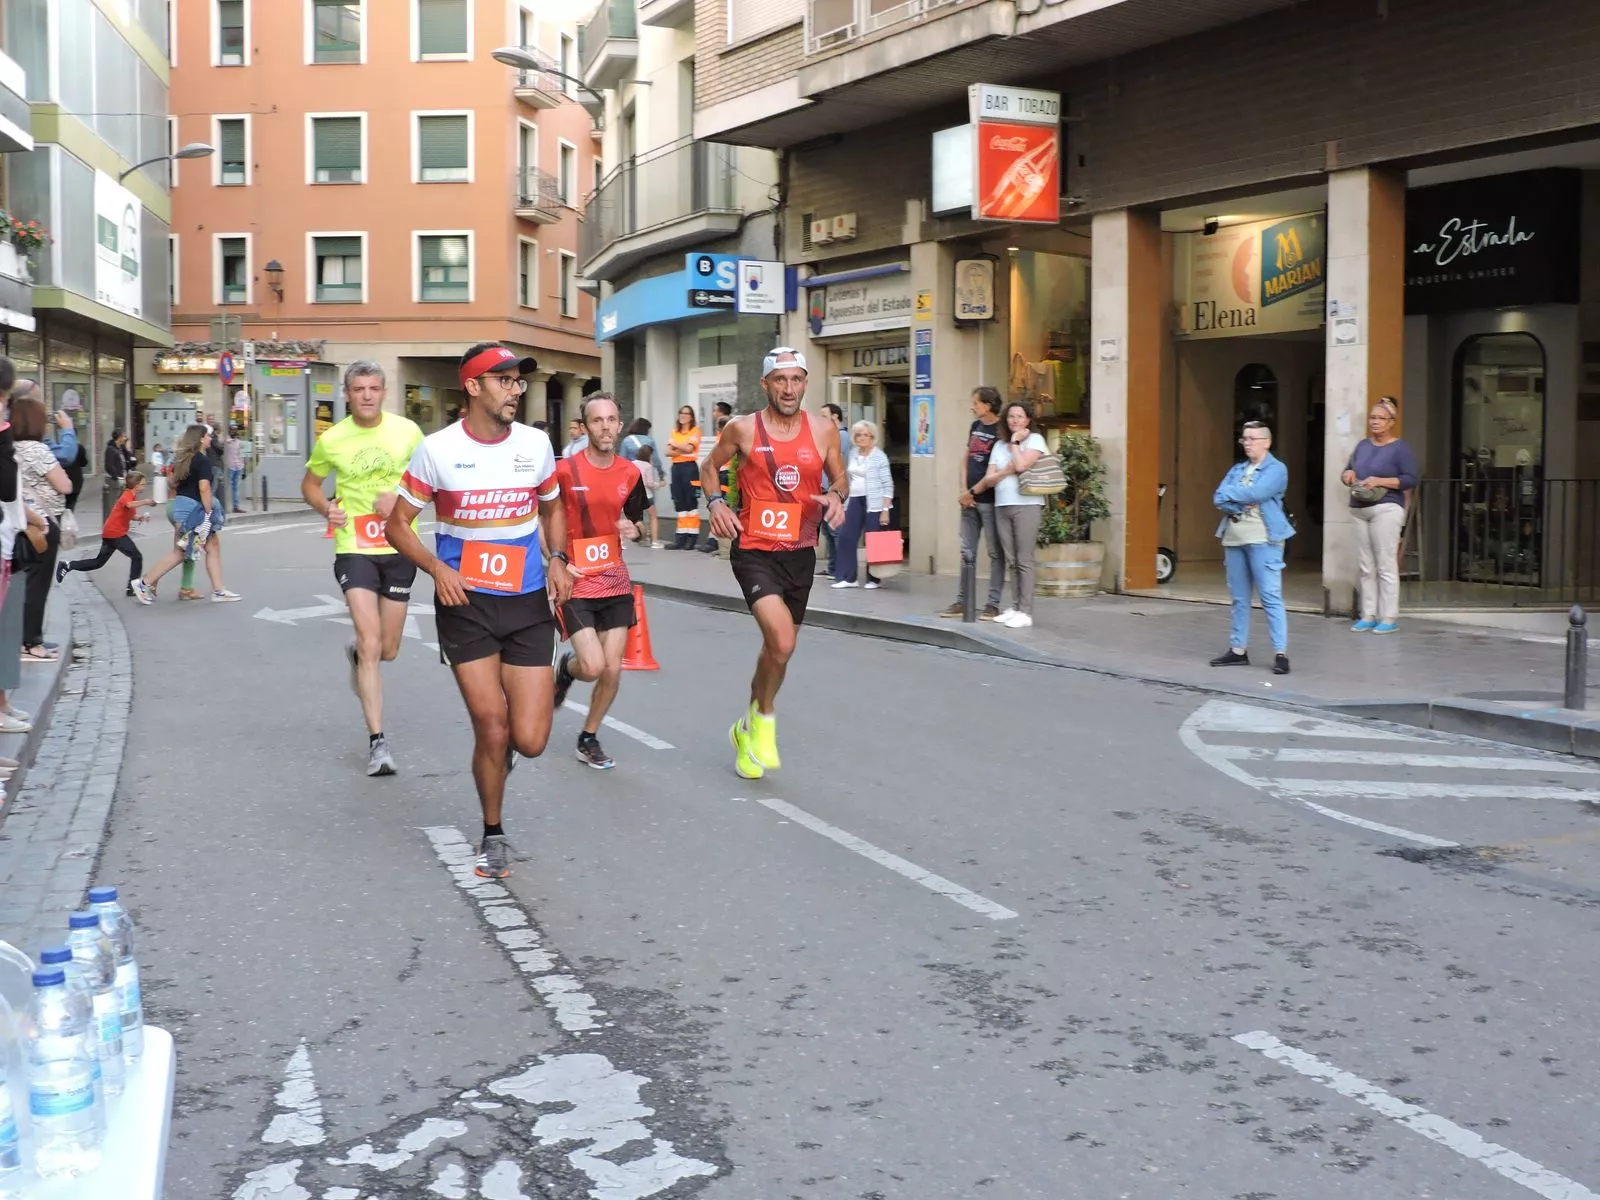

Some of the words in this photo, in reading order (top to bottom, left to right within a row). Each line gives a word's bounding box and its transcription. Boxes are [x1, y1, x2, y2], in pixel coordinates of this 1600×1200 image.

[985, 94, 1009, 111] BAR
[1018, 97, 1059, 116] TOBAZO
[1436, 215, 1535, 266] Estrada
[700, 260, 711, 272] B
[1193, 300, 1257, 331] Elena
[460, 490, 530, 508] julián
[761, 508, 789, 530] 02
[585, 543, 609, 562] 08
[479, 552, 508, 576] 10
